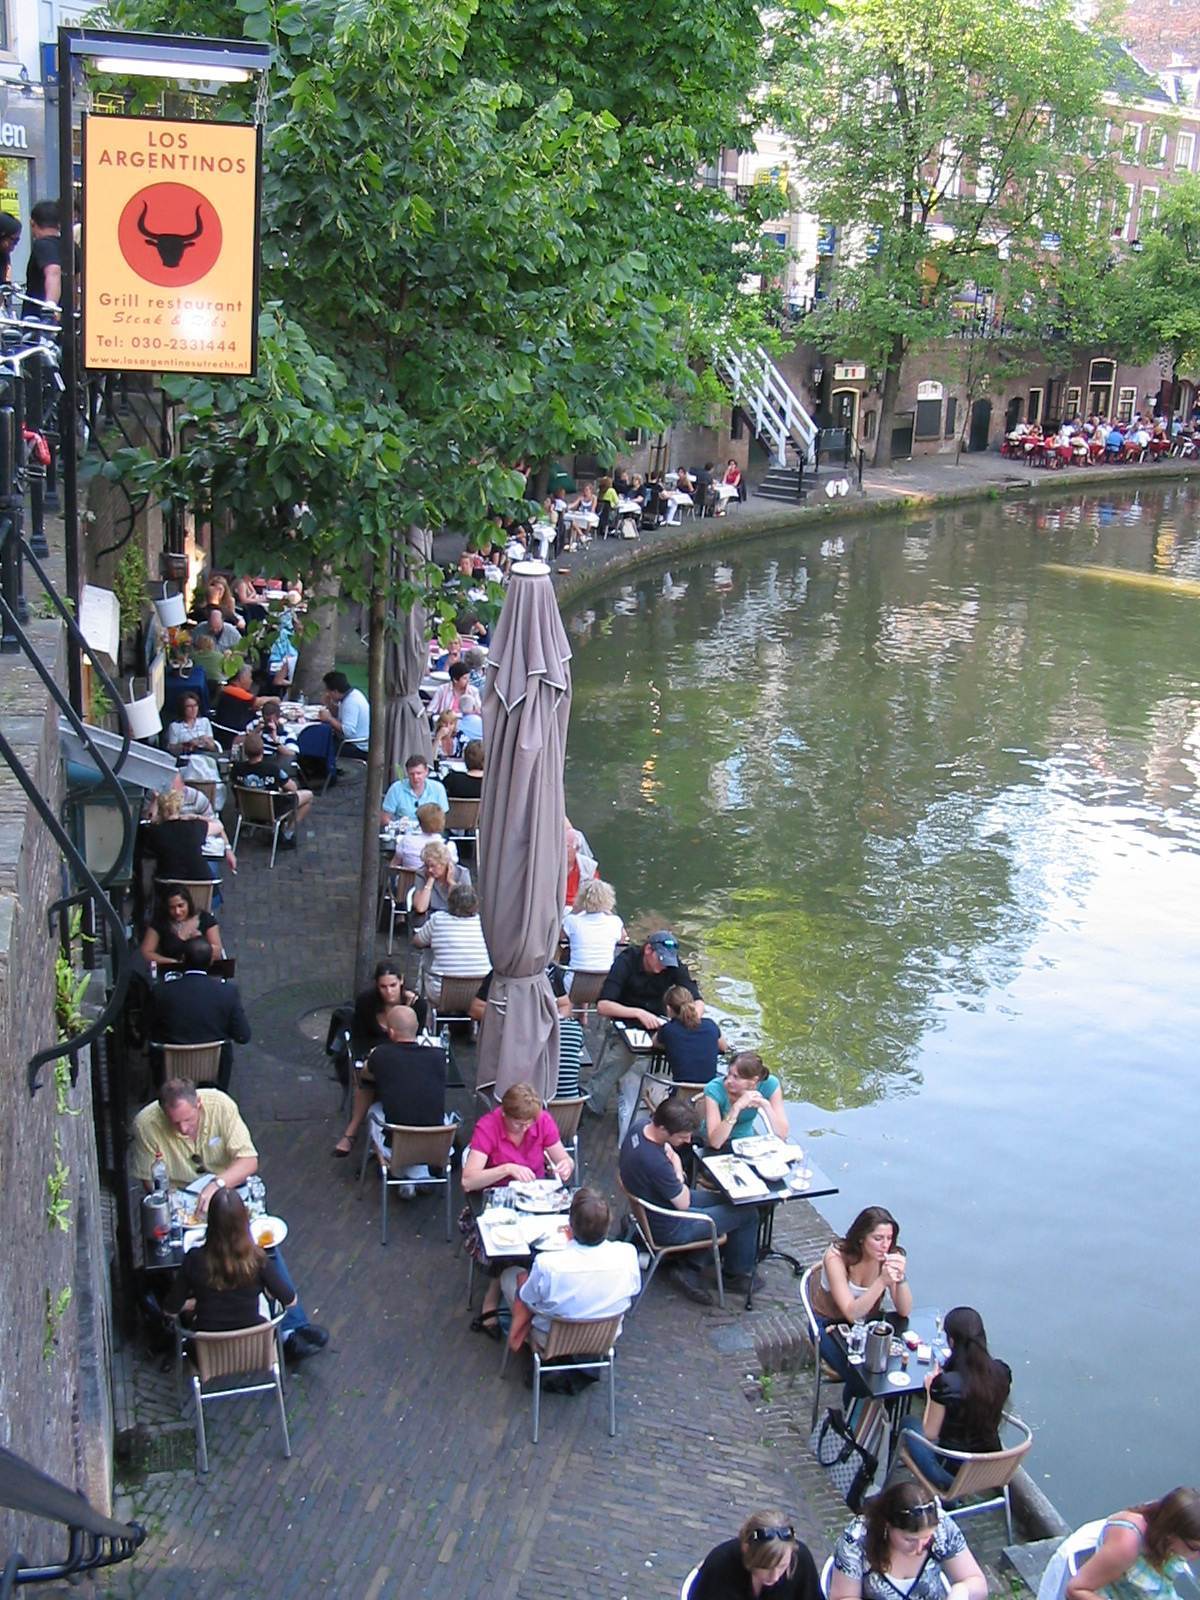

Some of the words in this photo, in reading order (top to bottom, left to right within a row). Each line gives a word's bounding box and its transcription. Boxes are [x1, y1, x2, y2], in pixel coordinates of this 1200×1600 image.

[0, 122, 28, 149] en
[148, 131, 188, 149] LOS
[98, 149, 246, 174] ARGENTINOS
[99, 292, 139, 308] Grill
[148, 297, 242, 313] restaurant
[112, 311, 163, 325] Steak
[170, 313, 181, 326] &
[96, 335, 124, 348] Tel:
[131, 336, 236, 352] 030-2331444
[89, 356, 248, 369] www.losargentinosutrecht.nl
